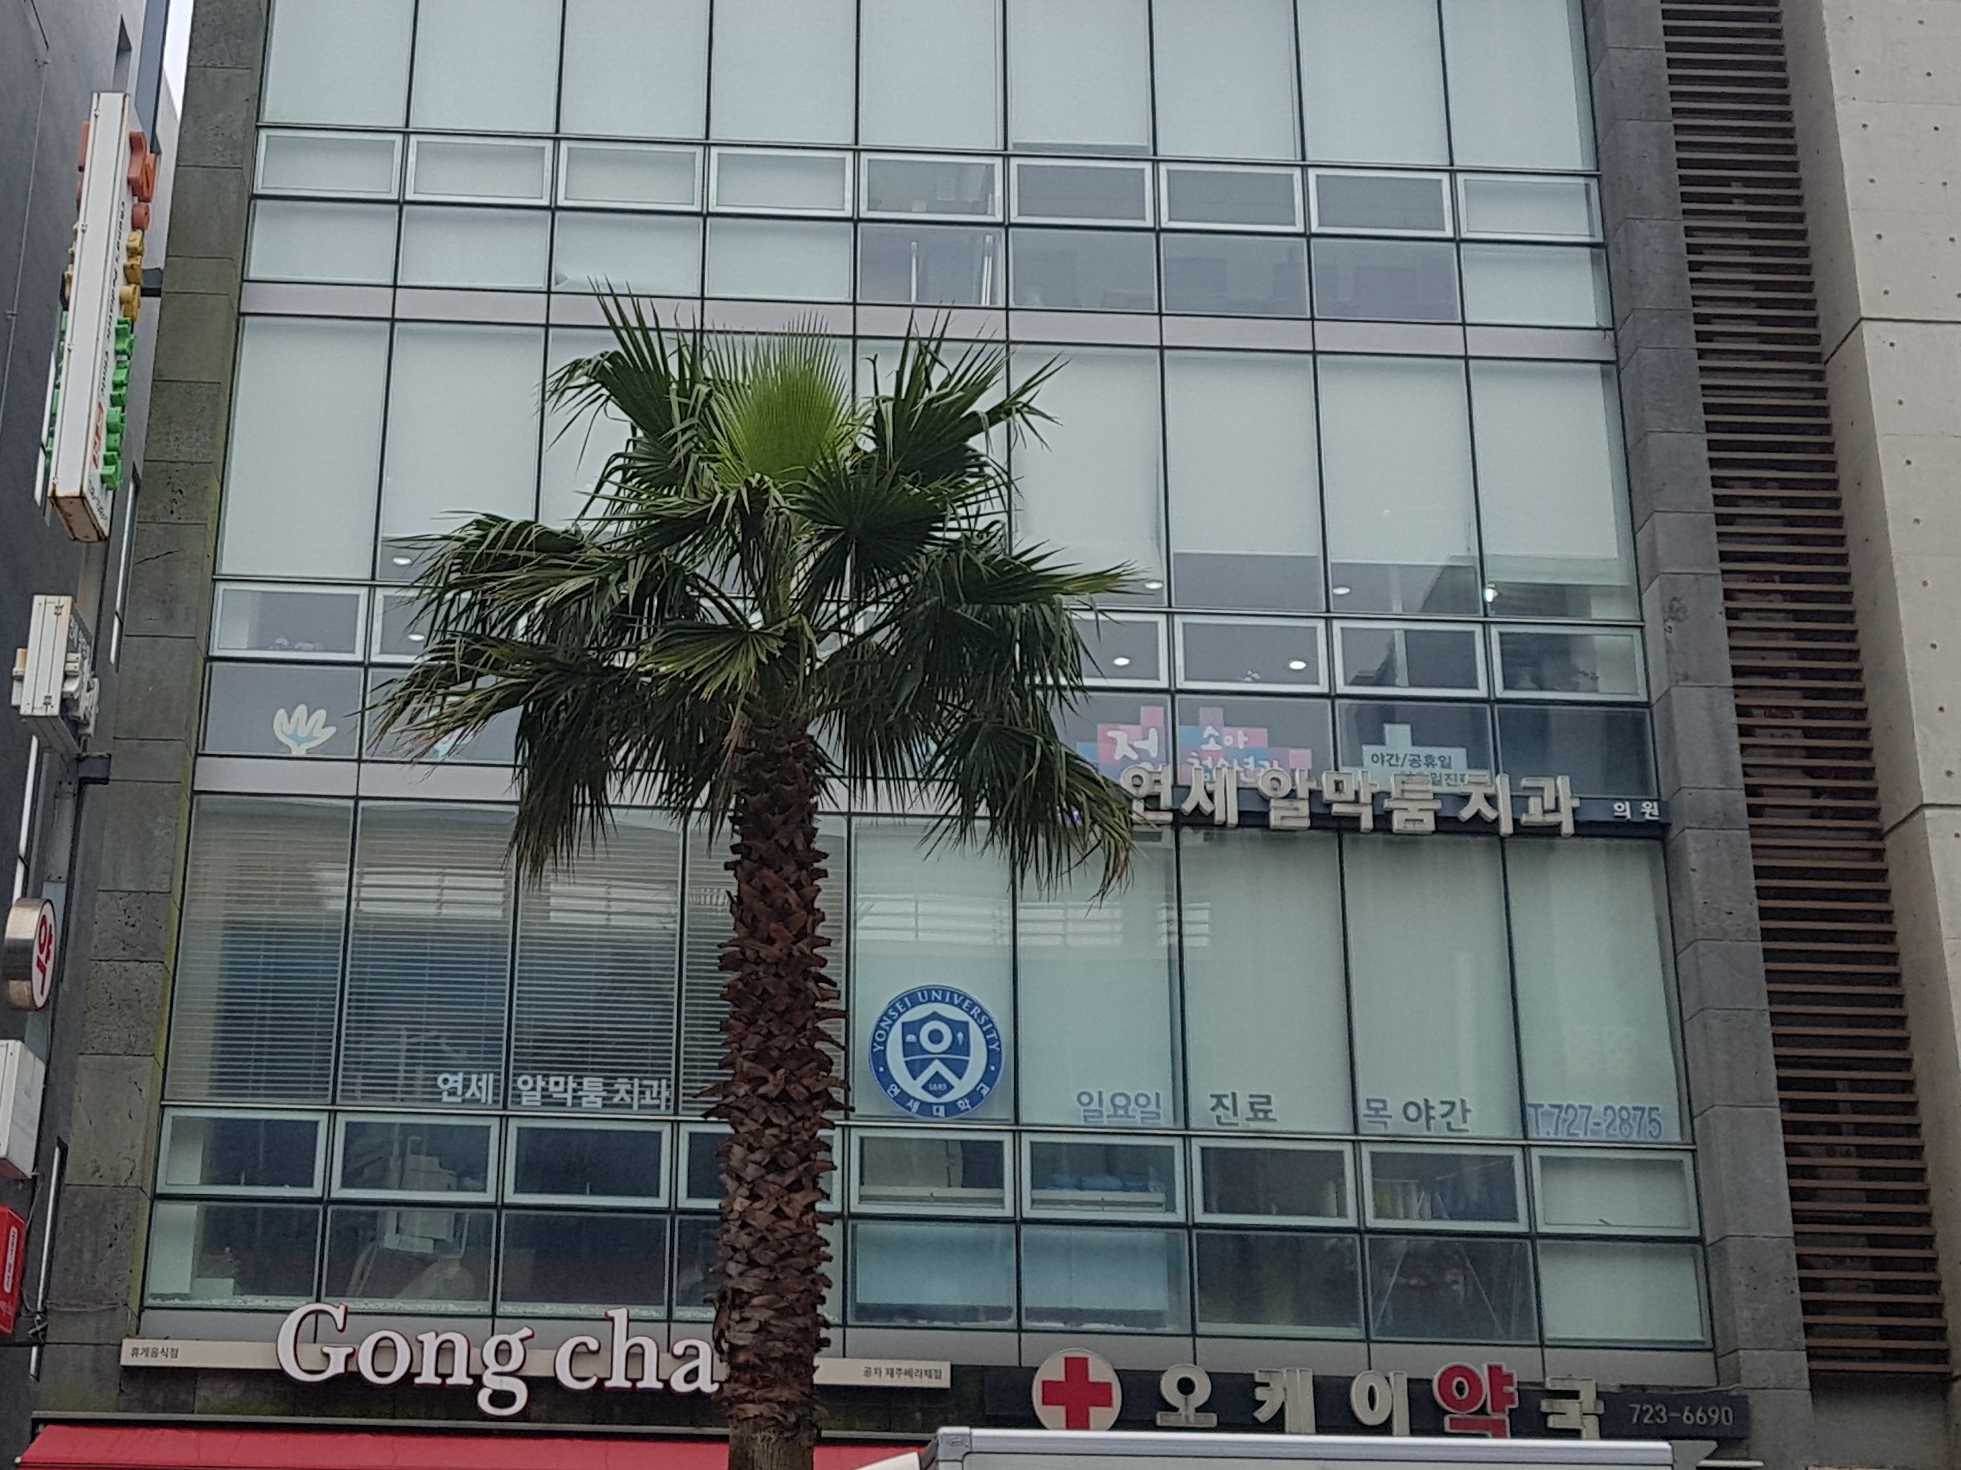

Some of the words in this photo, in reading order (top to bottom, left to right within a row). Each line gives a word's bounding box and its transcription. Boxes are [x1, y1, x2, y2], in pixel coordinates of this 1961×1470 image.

[1201, 725, 1248, 750] 소아
[1613, 801, 1660, 821] 의원
[36, 914, 54, 997] 약
[873, 997, 911, 1052] YONSEI
[916, 989, 1001, 1052] UNIVERSITY
[436, 1072, 494, 1105] 연세
[1076, 1089, 1162, 1125] 일요일
[1208, 1091, 1278, 1127] 진료
[1401, 1097, 1473, 1133] 야간
[1527, 1102, 1663, 1140] T.727-2875
[276, 1302, 534, 1417] Gong
[555, 1307, 721, 1394] cha
[1629, 1403, 1735, 1427] 723-6690
